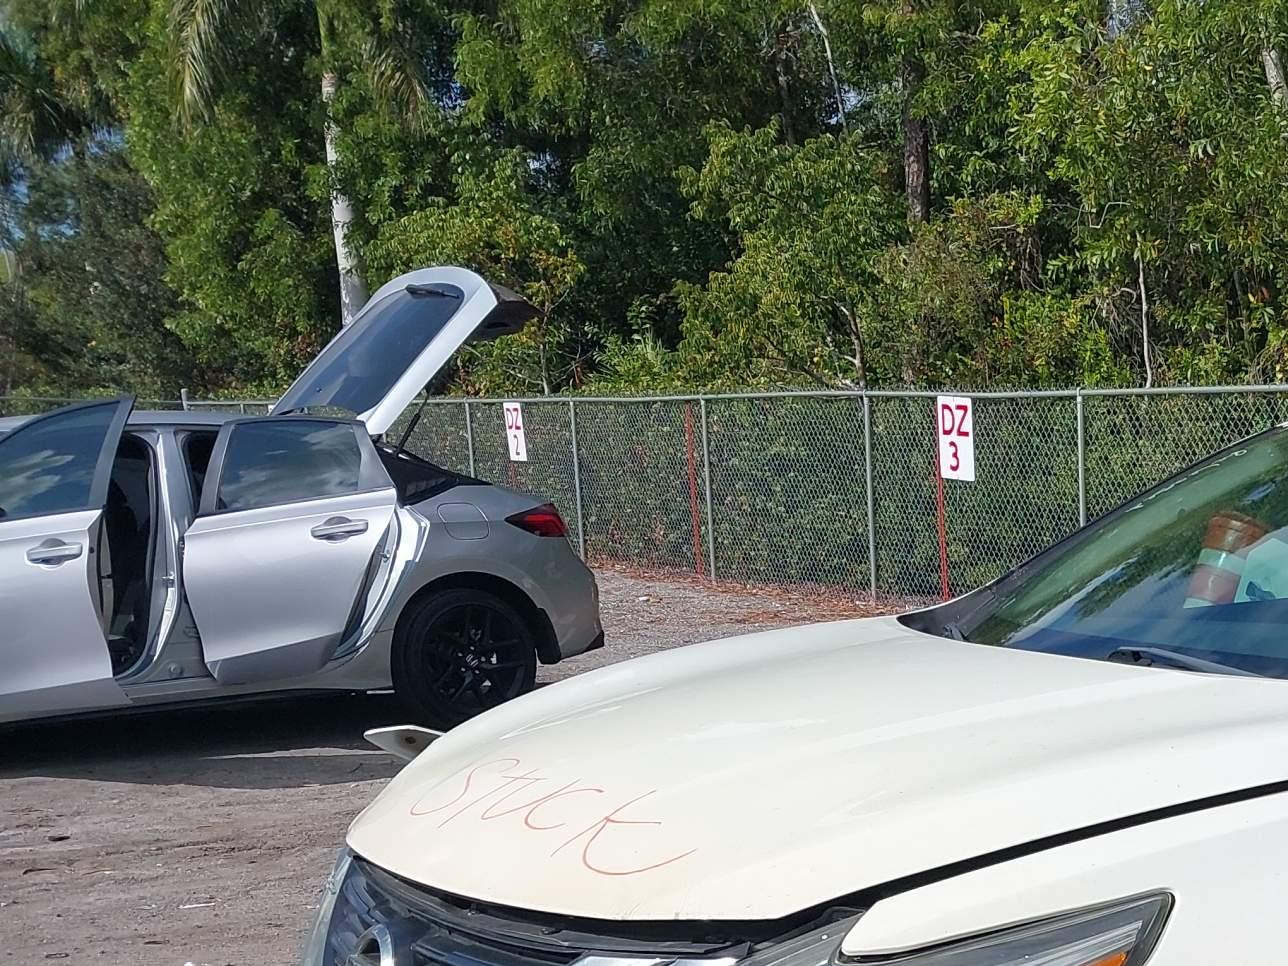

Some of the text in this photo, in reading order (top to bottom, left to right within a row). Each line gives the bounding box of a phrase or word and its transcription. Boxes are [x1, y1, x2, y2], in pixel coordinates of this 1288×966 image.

[505, 408, 521, 430] DZ
[941, 404, 969, 437] DZ
[949, 441, 960, 471] 3
